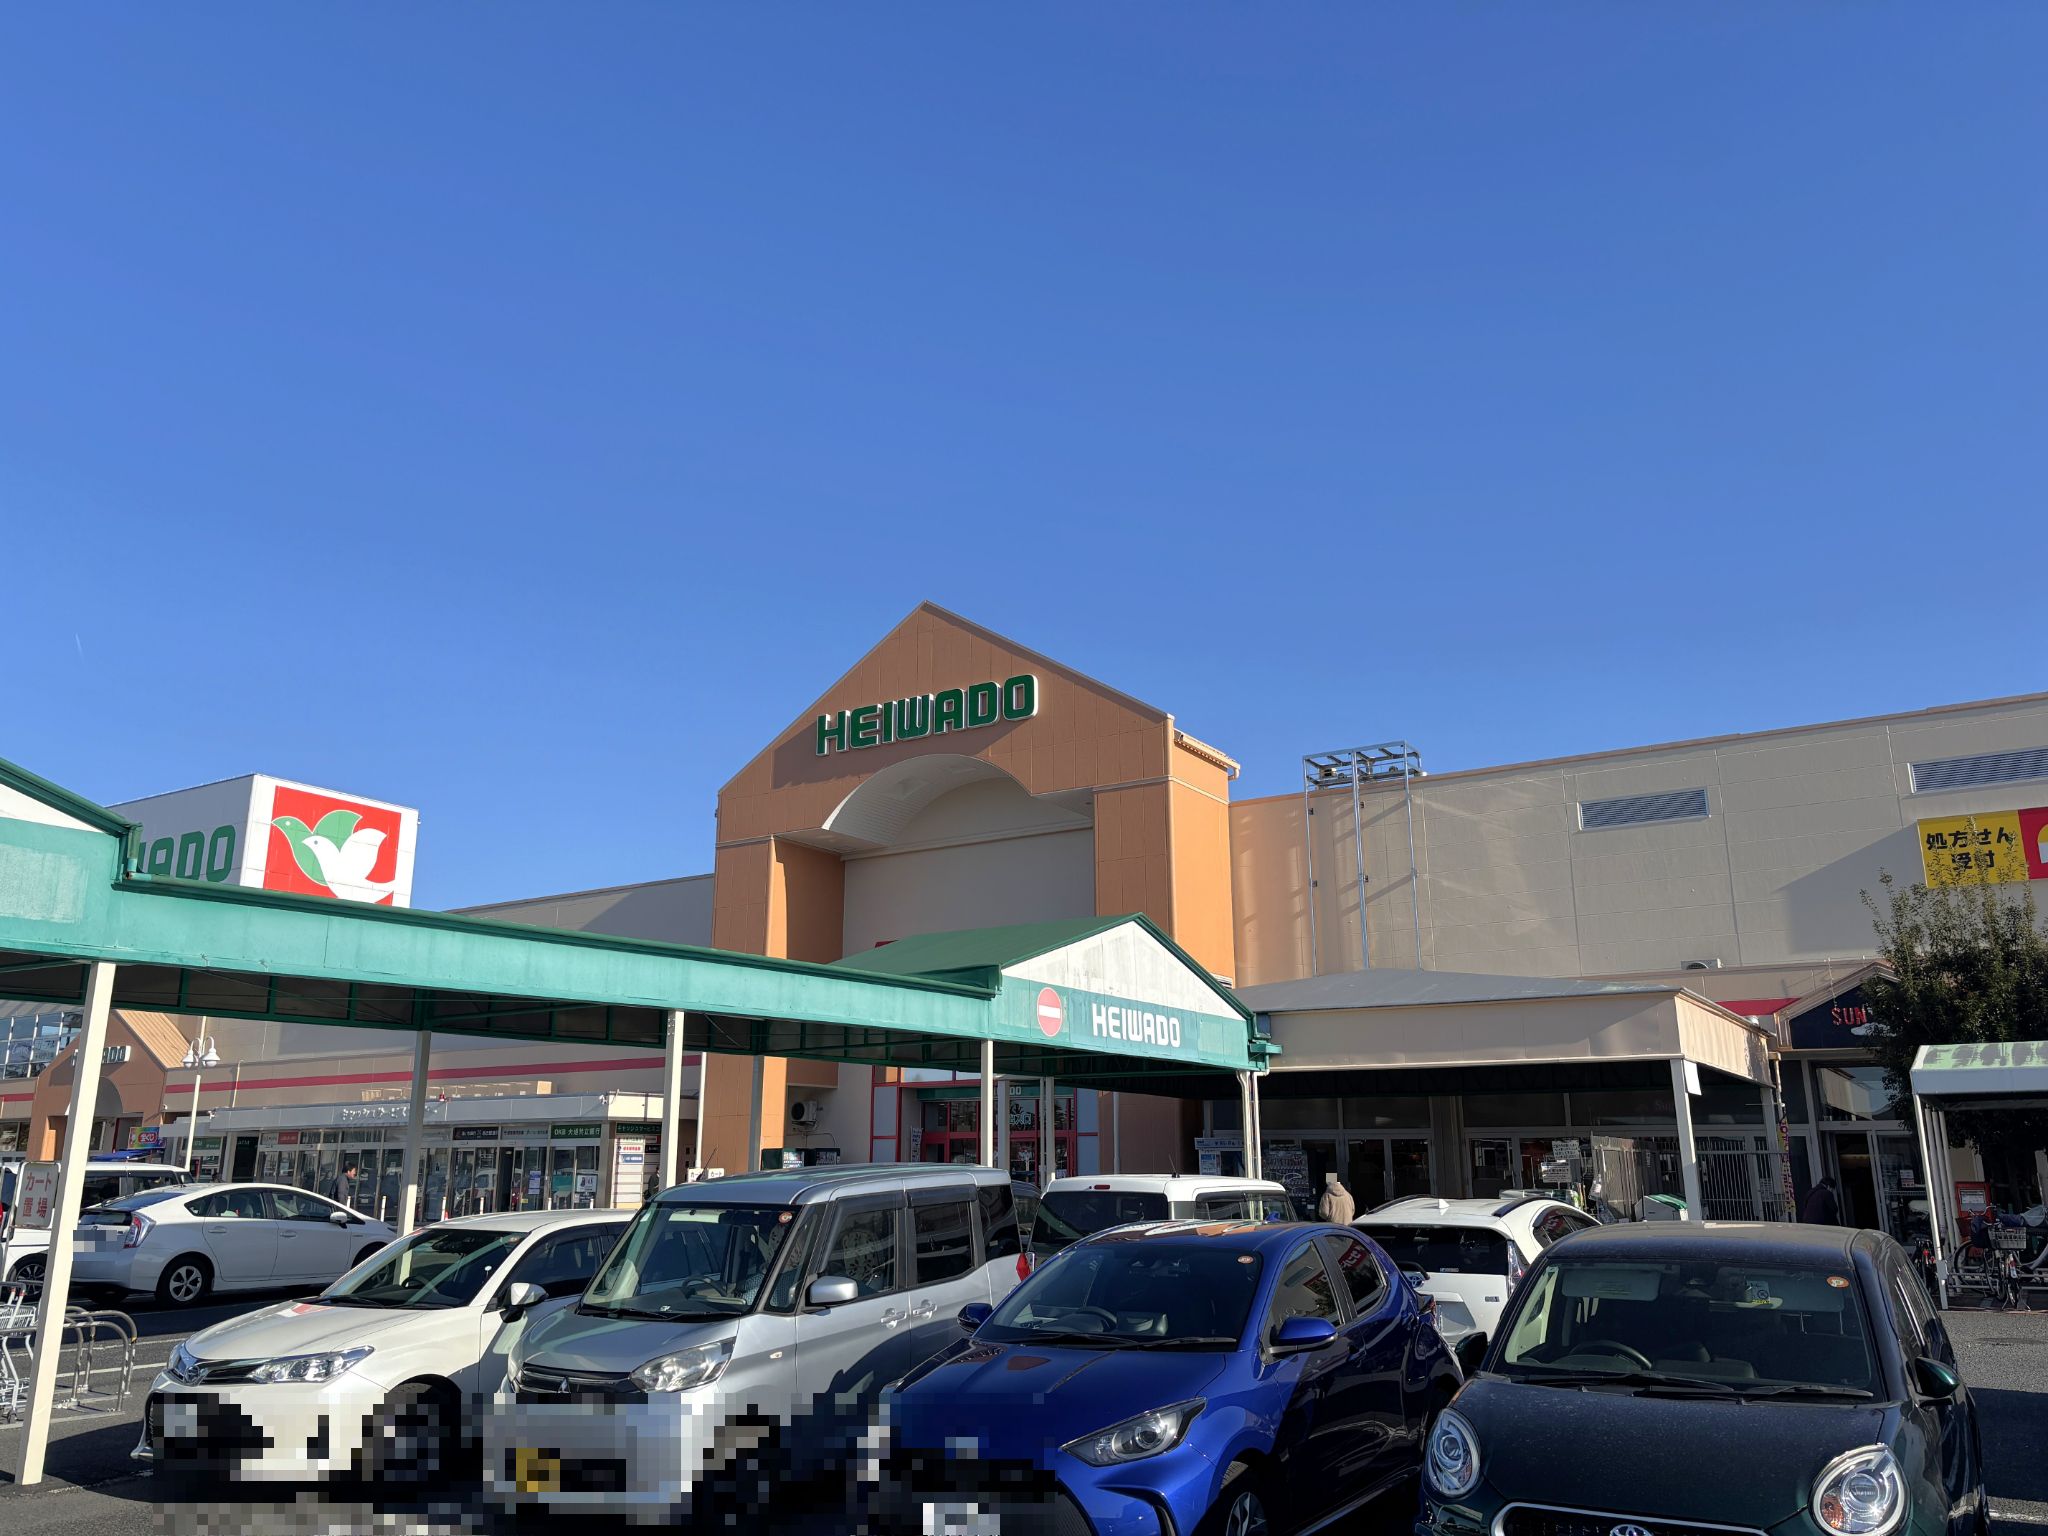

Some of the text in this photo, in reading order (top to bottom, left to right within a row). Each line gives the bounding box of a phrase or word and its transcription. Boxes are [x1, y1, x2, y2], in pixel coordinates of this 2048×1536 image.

[816, 674, 1038, 755] HEIWADO
[1092, 1003, 1180, 1048] HEIWADO
[25, 1171, 52, 1192] カート
[22, 1197, 48, 1218] 置場
